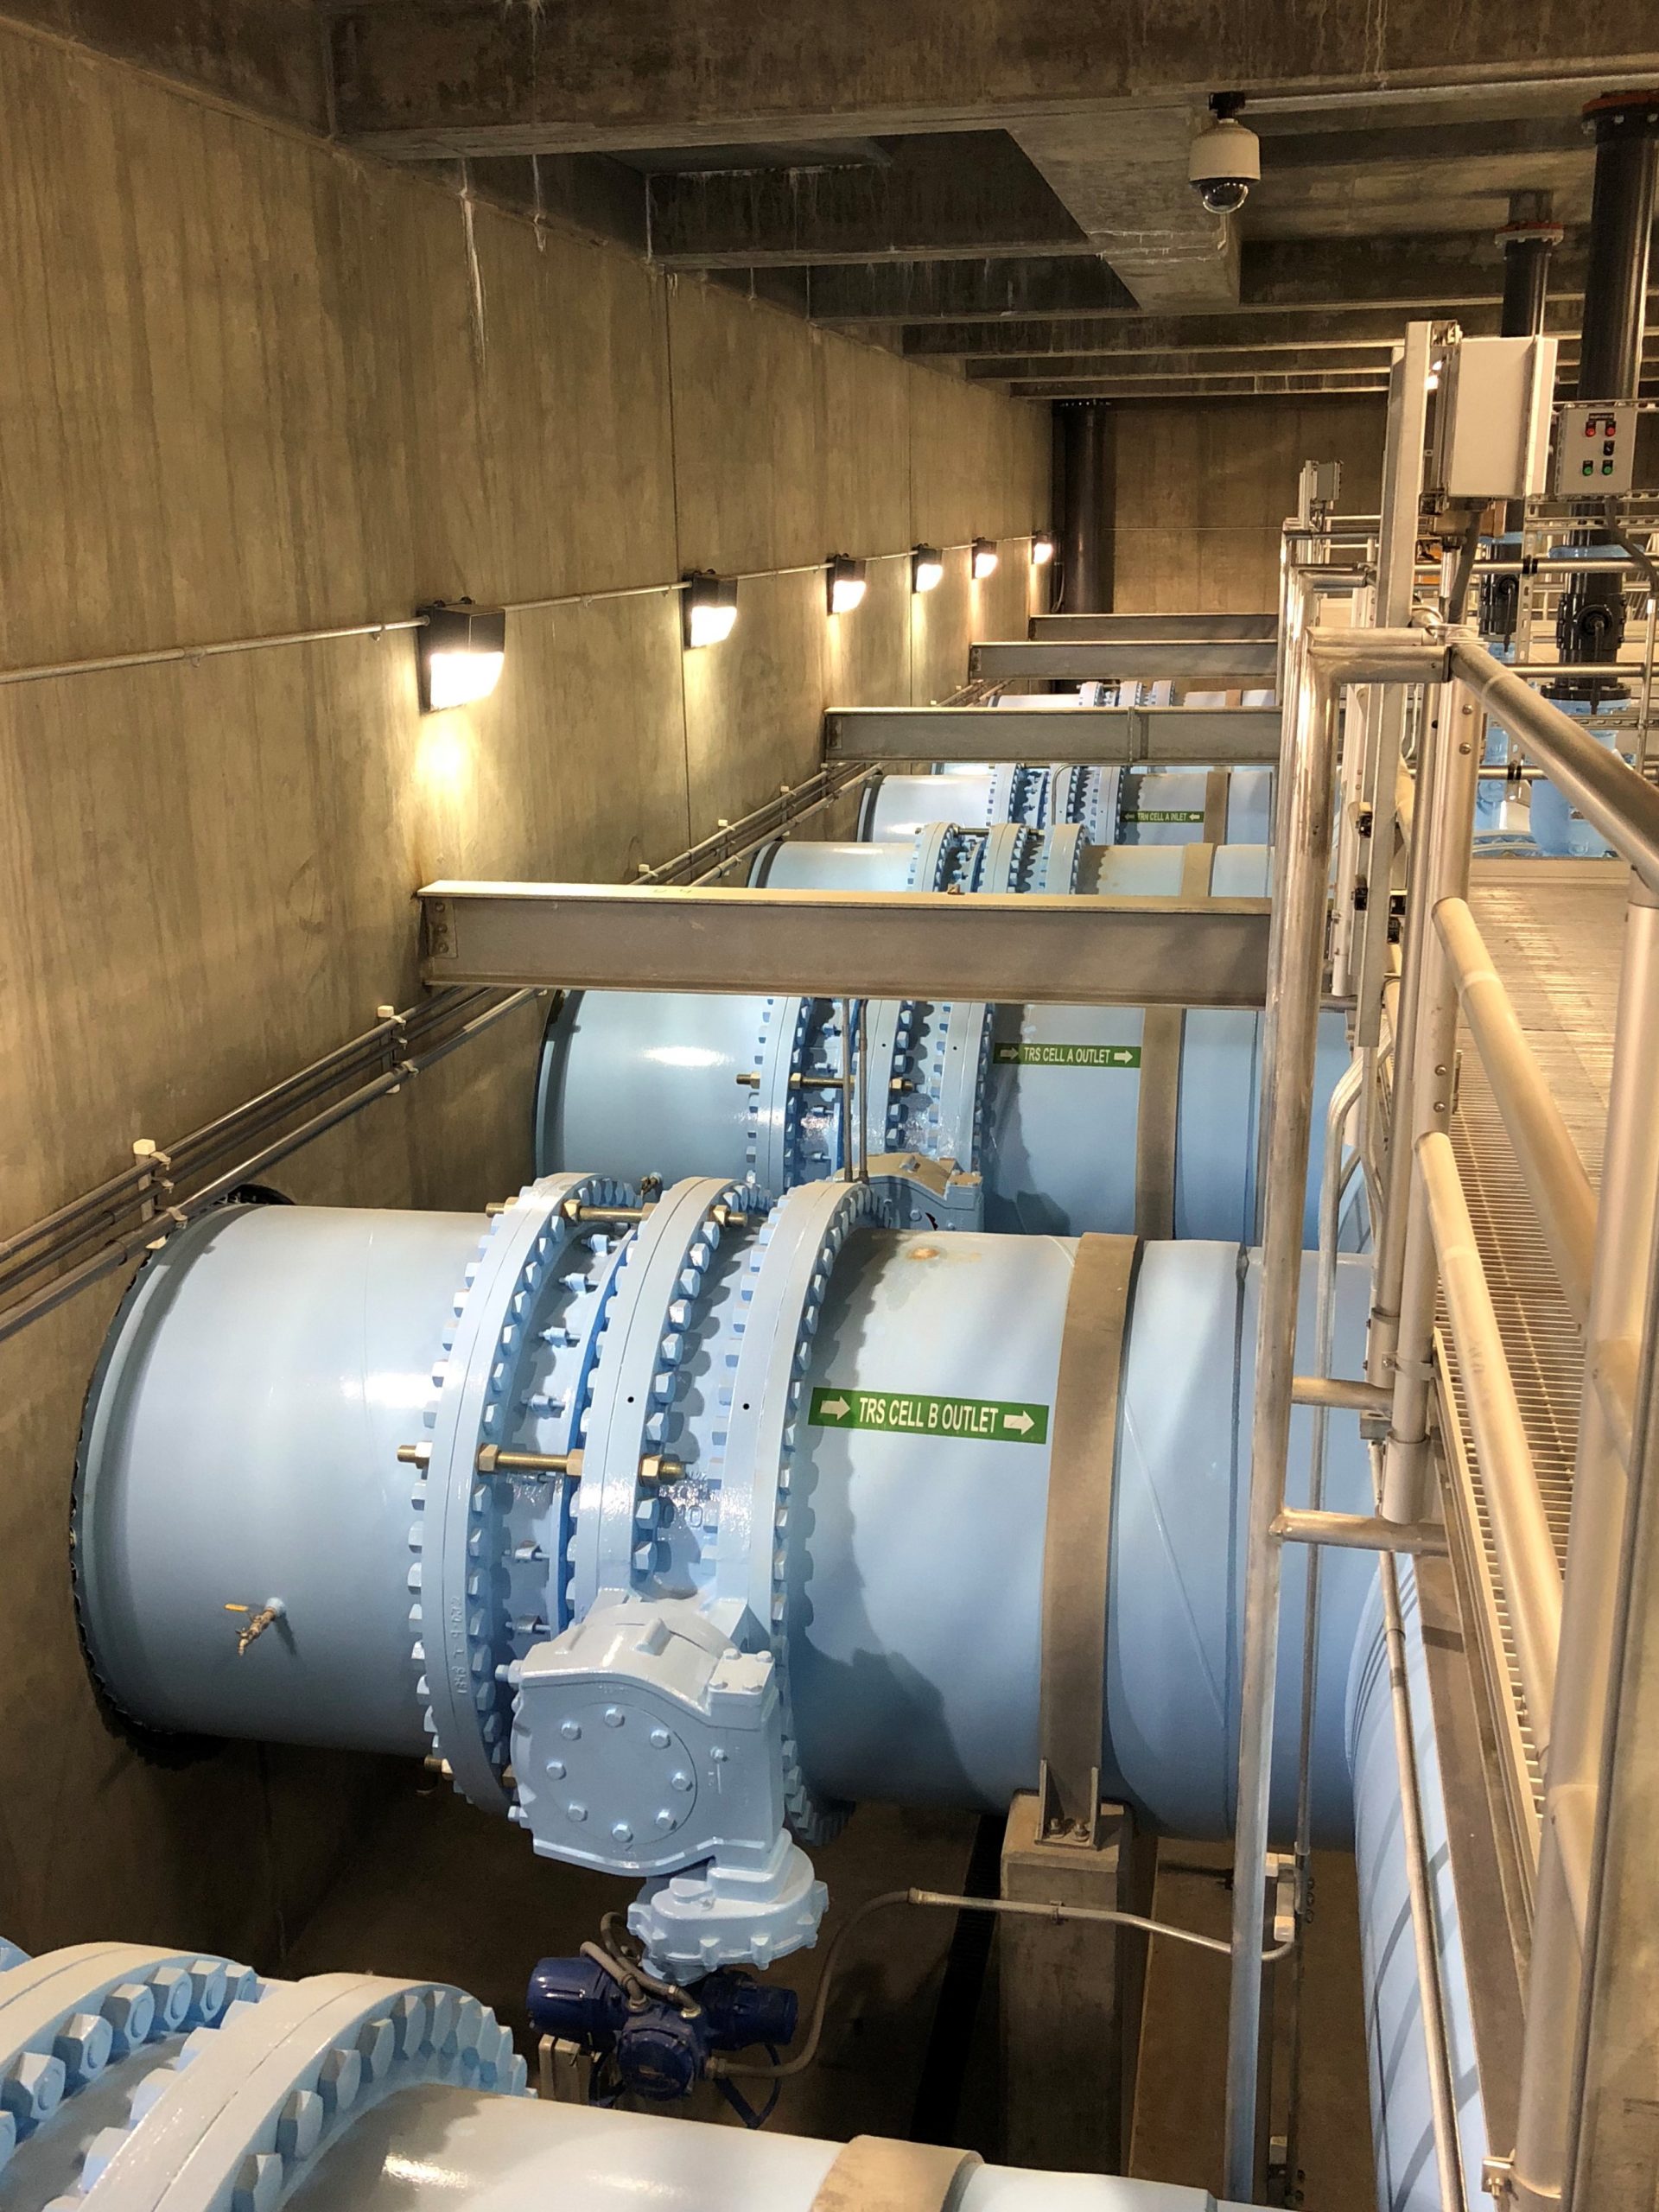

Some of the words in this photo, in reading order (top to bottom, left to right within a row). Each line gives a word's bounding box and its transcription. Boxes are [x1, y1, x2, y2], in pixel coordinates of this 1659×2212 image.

[1149, 812, 1164, 821] CELL
[1165, 812, 1170, 821] A
[1170, 812, 1187, 821] INLET
[1024, 1046, 1041, 1062] TRS
[1042, 1047, 1065, 1062] CELL
[1066, 1048, 1074, 1063] A
[1075, 1048, 1111, 1064] OUTLET
[859, 1397, 886, 1424] TRS
[888, 1400, 925, 1427] CELL
[927, 1402, 939, 1429] B
[941, 1403, 999, 1433] OUTLET
